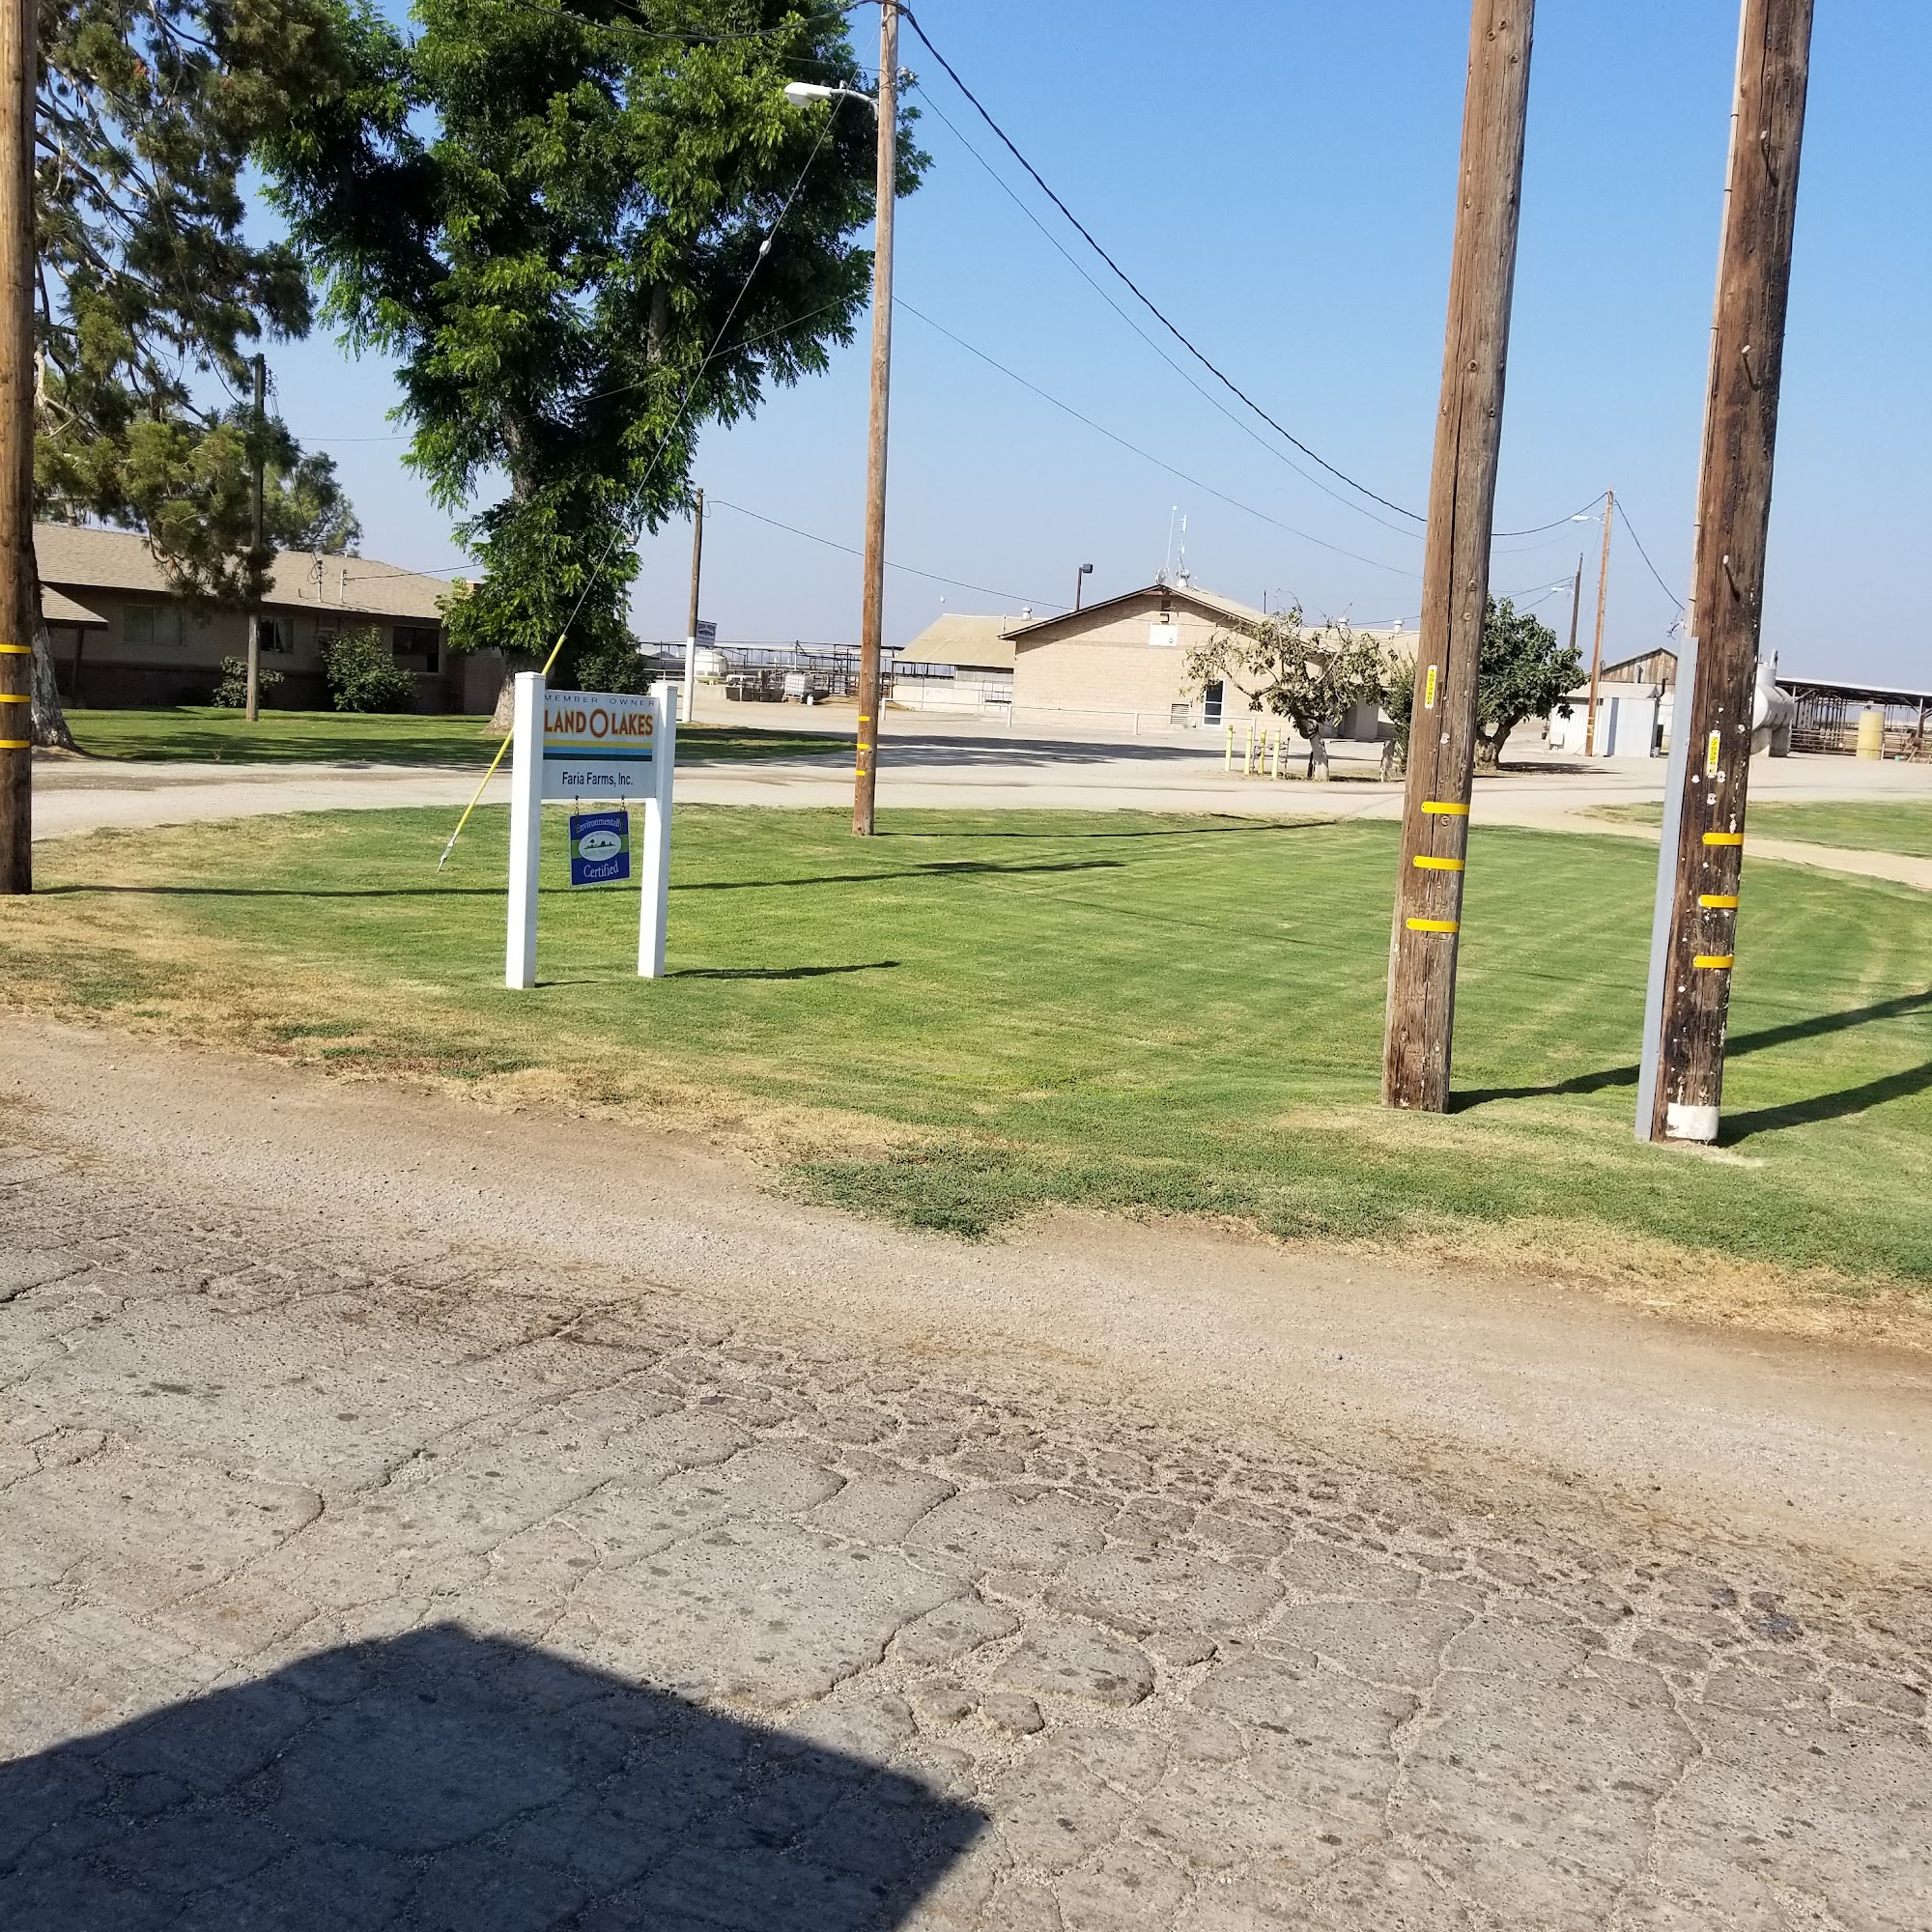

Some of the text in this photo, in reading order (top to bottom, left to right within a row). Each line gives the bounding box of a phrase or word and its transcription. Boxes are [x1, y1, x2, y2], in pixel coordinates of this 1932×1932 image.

[544, 695, 655, 707] MEMBER OWNER
[544, 707, 654, 738] LAND O LAKES
[562, 772, 634, 787] Faria Farms, Inc.
[576, 817, 622, 834] Environmentally
[583, 861, 619, 878] Certified
